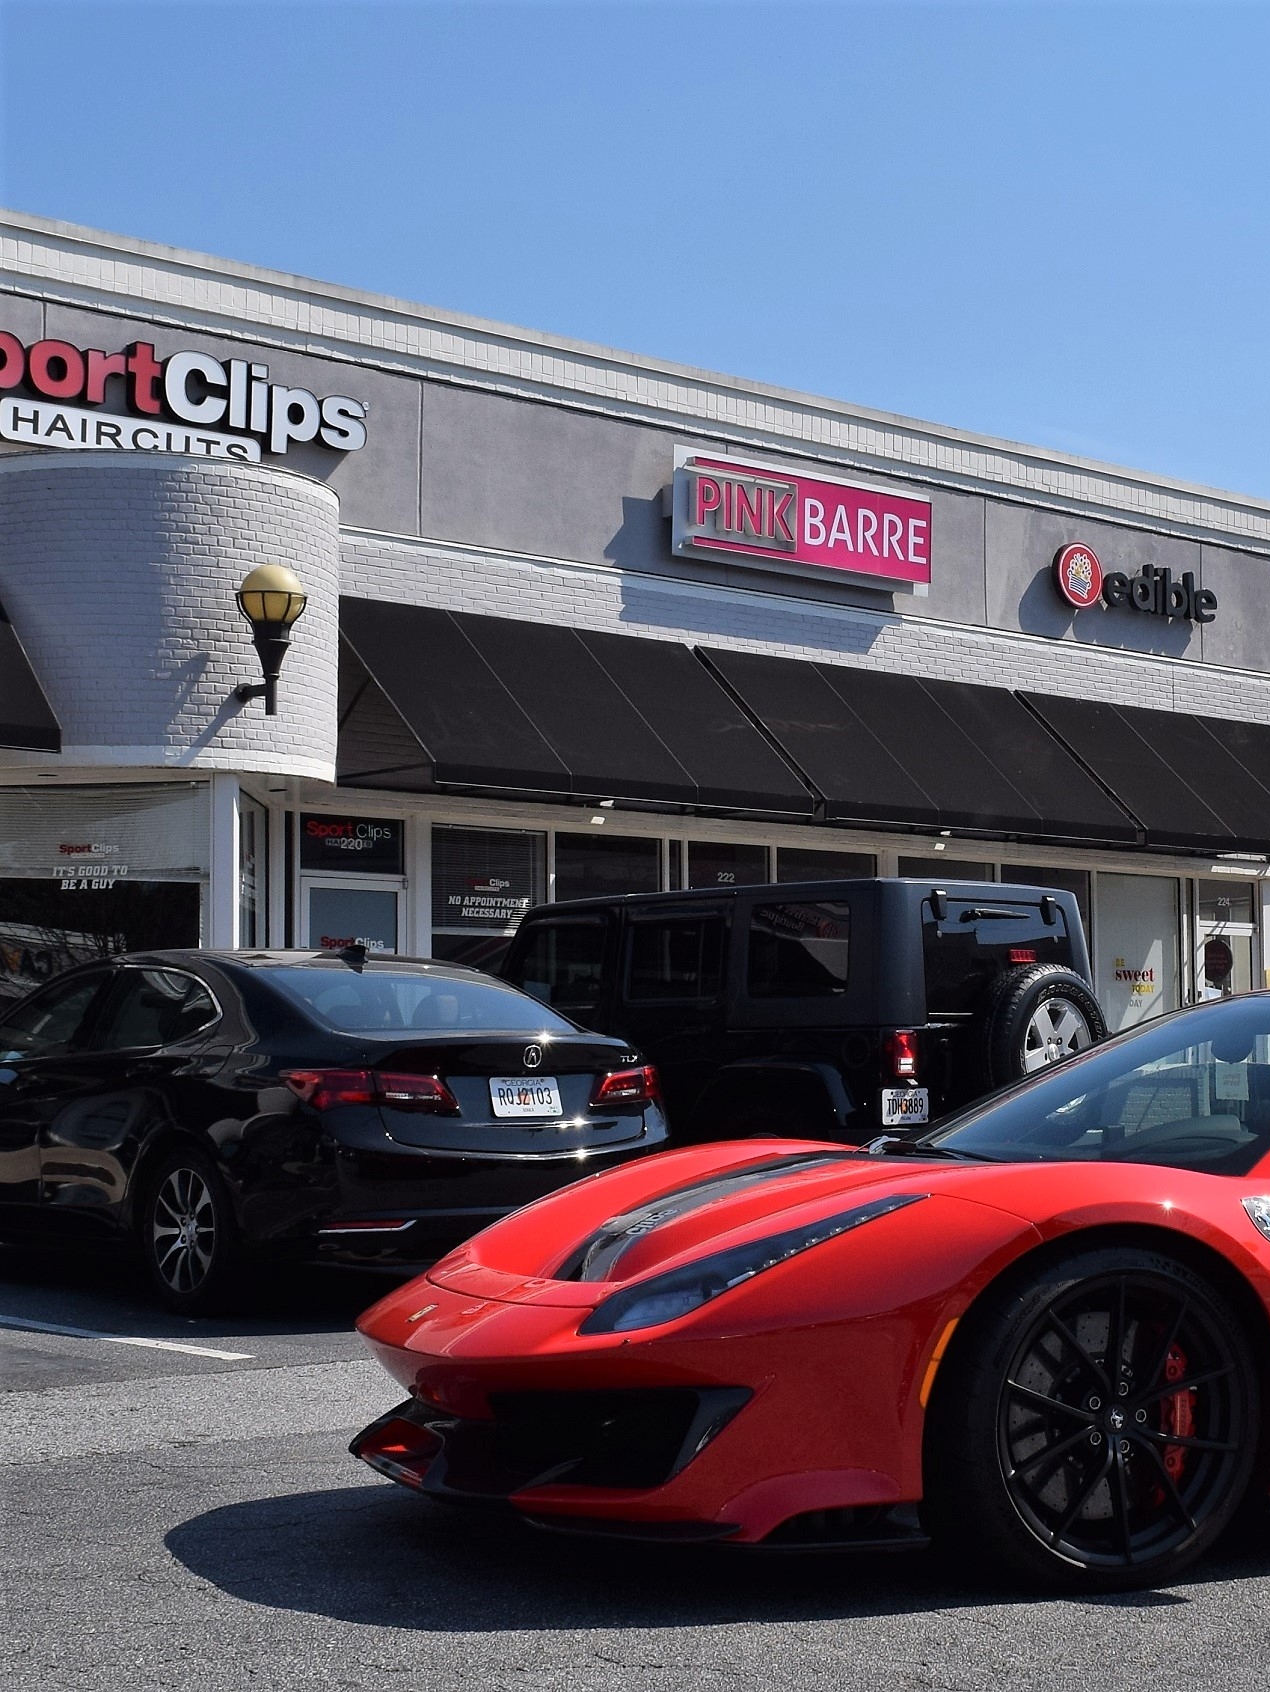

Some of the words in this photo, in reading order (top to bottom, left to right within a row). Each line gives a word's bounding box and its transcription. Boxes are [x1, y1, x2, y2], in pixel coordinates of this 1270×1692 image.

[12, 406, 249, 462] HAIRCUTS
[696, 476, 794, 542] PINK
[804, 497, 927, 565] BARRE
[1102, 563, 1218, 624] edible
[340, 837, 364, 850] 220
[52, 866, 76, 878] IT'S
[78, 865, 109, 877] GOOD
[112, 865, 129, 876] TO
[717, 871, 736, 883] 222
[60, 879, 78, 890] BE
[79, 880, 89, 890] A
[91, 879, 116, 890] GUY
[448, 896, 462, 906] NO
[463, 896, 529, 909] APPOINTMENT
[461, 907, 514, 919] NECESSARY
[1115, 958, 1125, 967] BE
[1115, 967, 1155, 982] sweet
[1131, 984, 1155, 993] TODAY
[620, 1054, 638, 1063] TLX
[504, 1079, 543, 1087] GEORGIA
